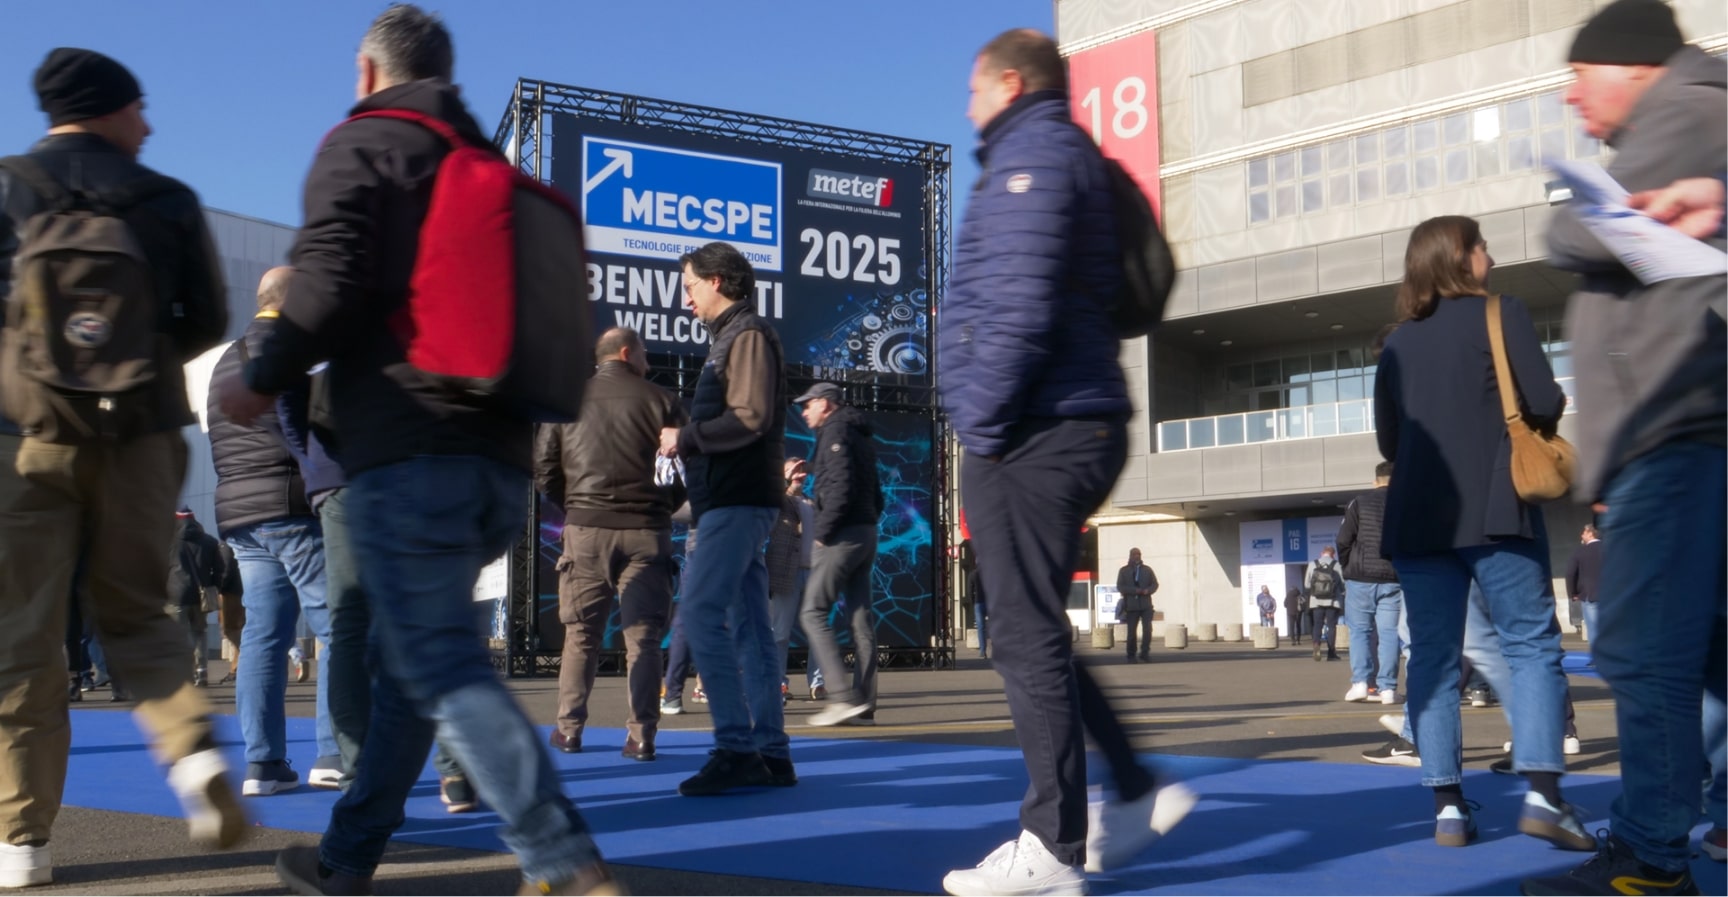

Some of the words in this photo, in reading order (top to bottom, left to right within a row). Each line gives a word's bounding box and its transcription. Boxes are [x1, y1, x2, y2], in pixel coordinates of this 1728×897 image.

[1081, 76, 1148, 147] 18
[813, 174, 888, 207] metef
[622, 187, 773, 240] MECSPE
[623, 238, 682, 254] TECNOLOGIE
[800, 227, 901, 285] 2025
[1289, 538, 1300, 551] 16
